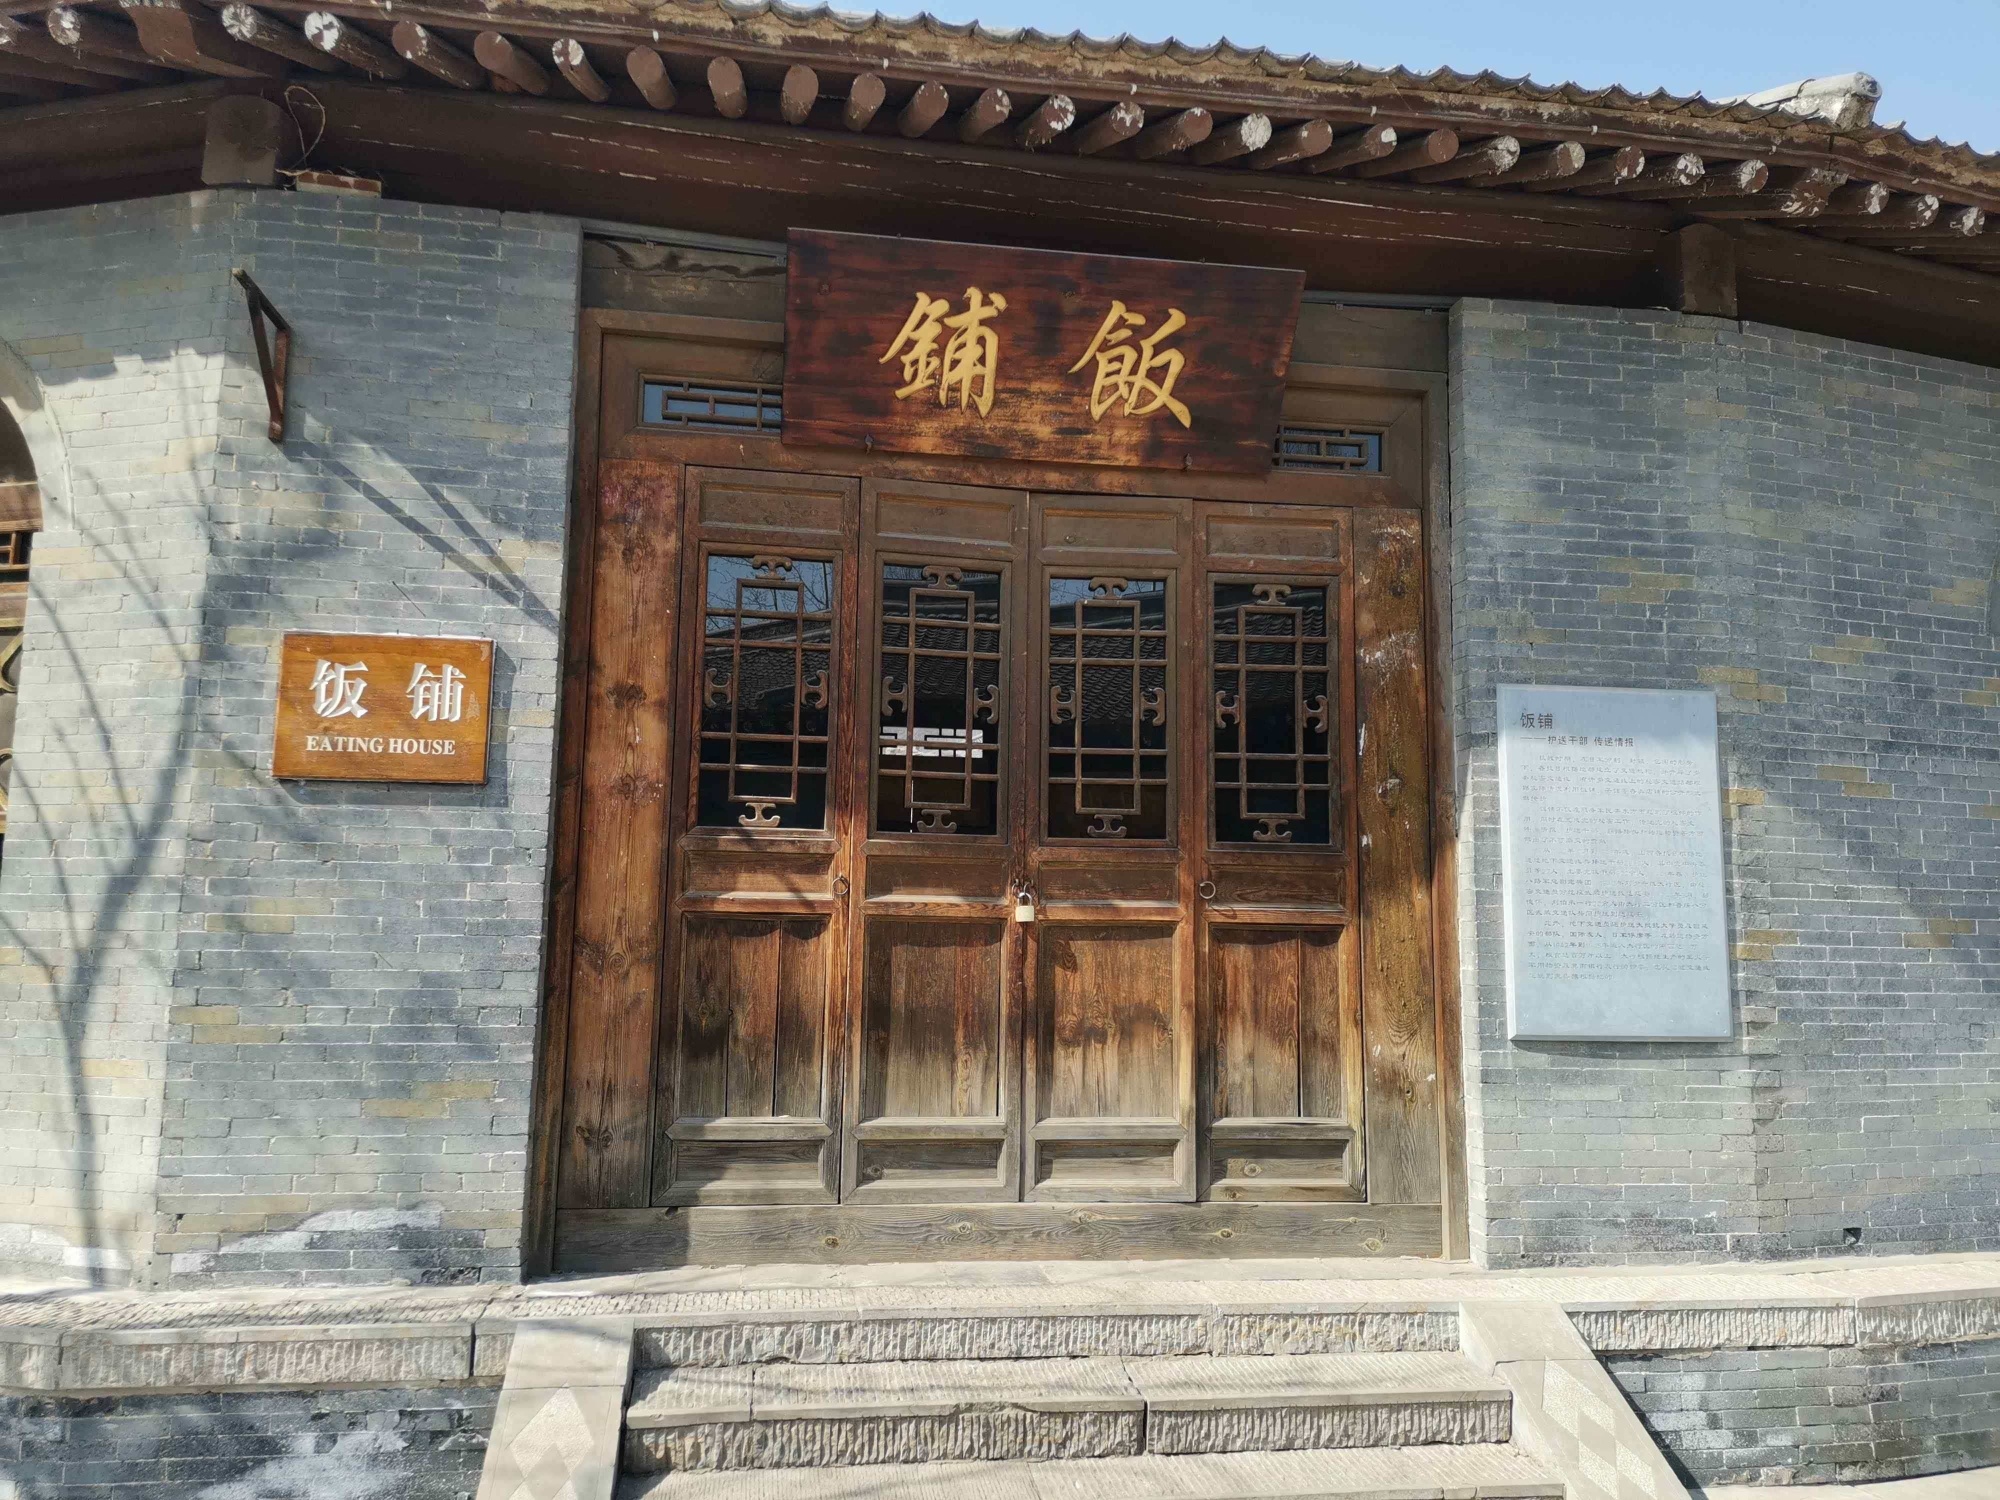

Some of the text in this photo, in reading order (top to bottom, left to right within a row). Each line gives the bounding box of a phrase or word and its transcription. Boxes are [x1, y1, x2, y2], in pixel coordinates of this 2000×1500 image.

[309, 658, 467, 723] 饭铺
[1519, 711, 1554, 731] 饭铺
[305, 734, 456, 756] EATING HOUSE
